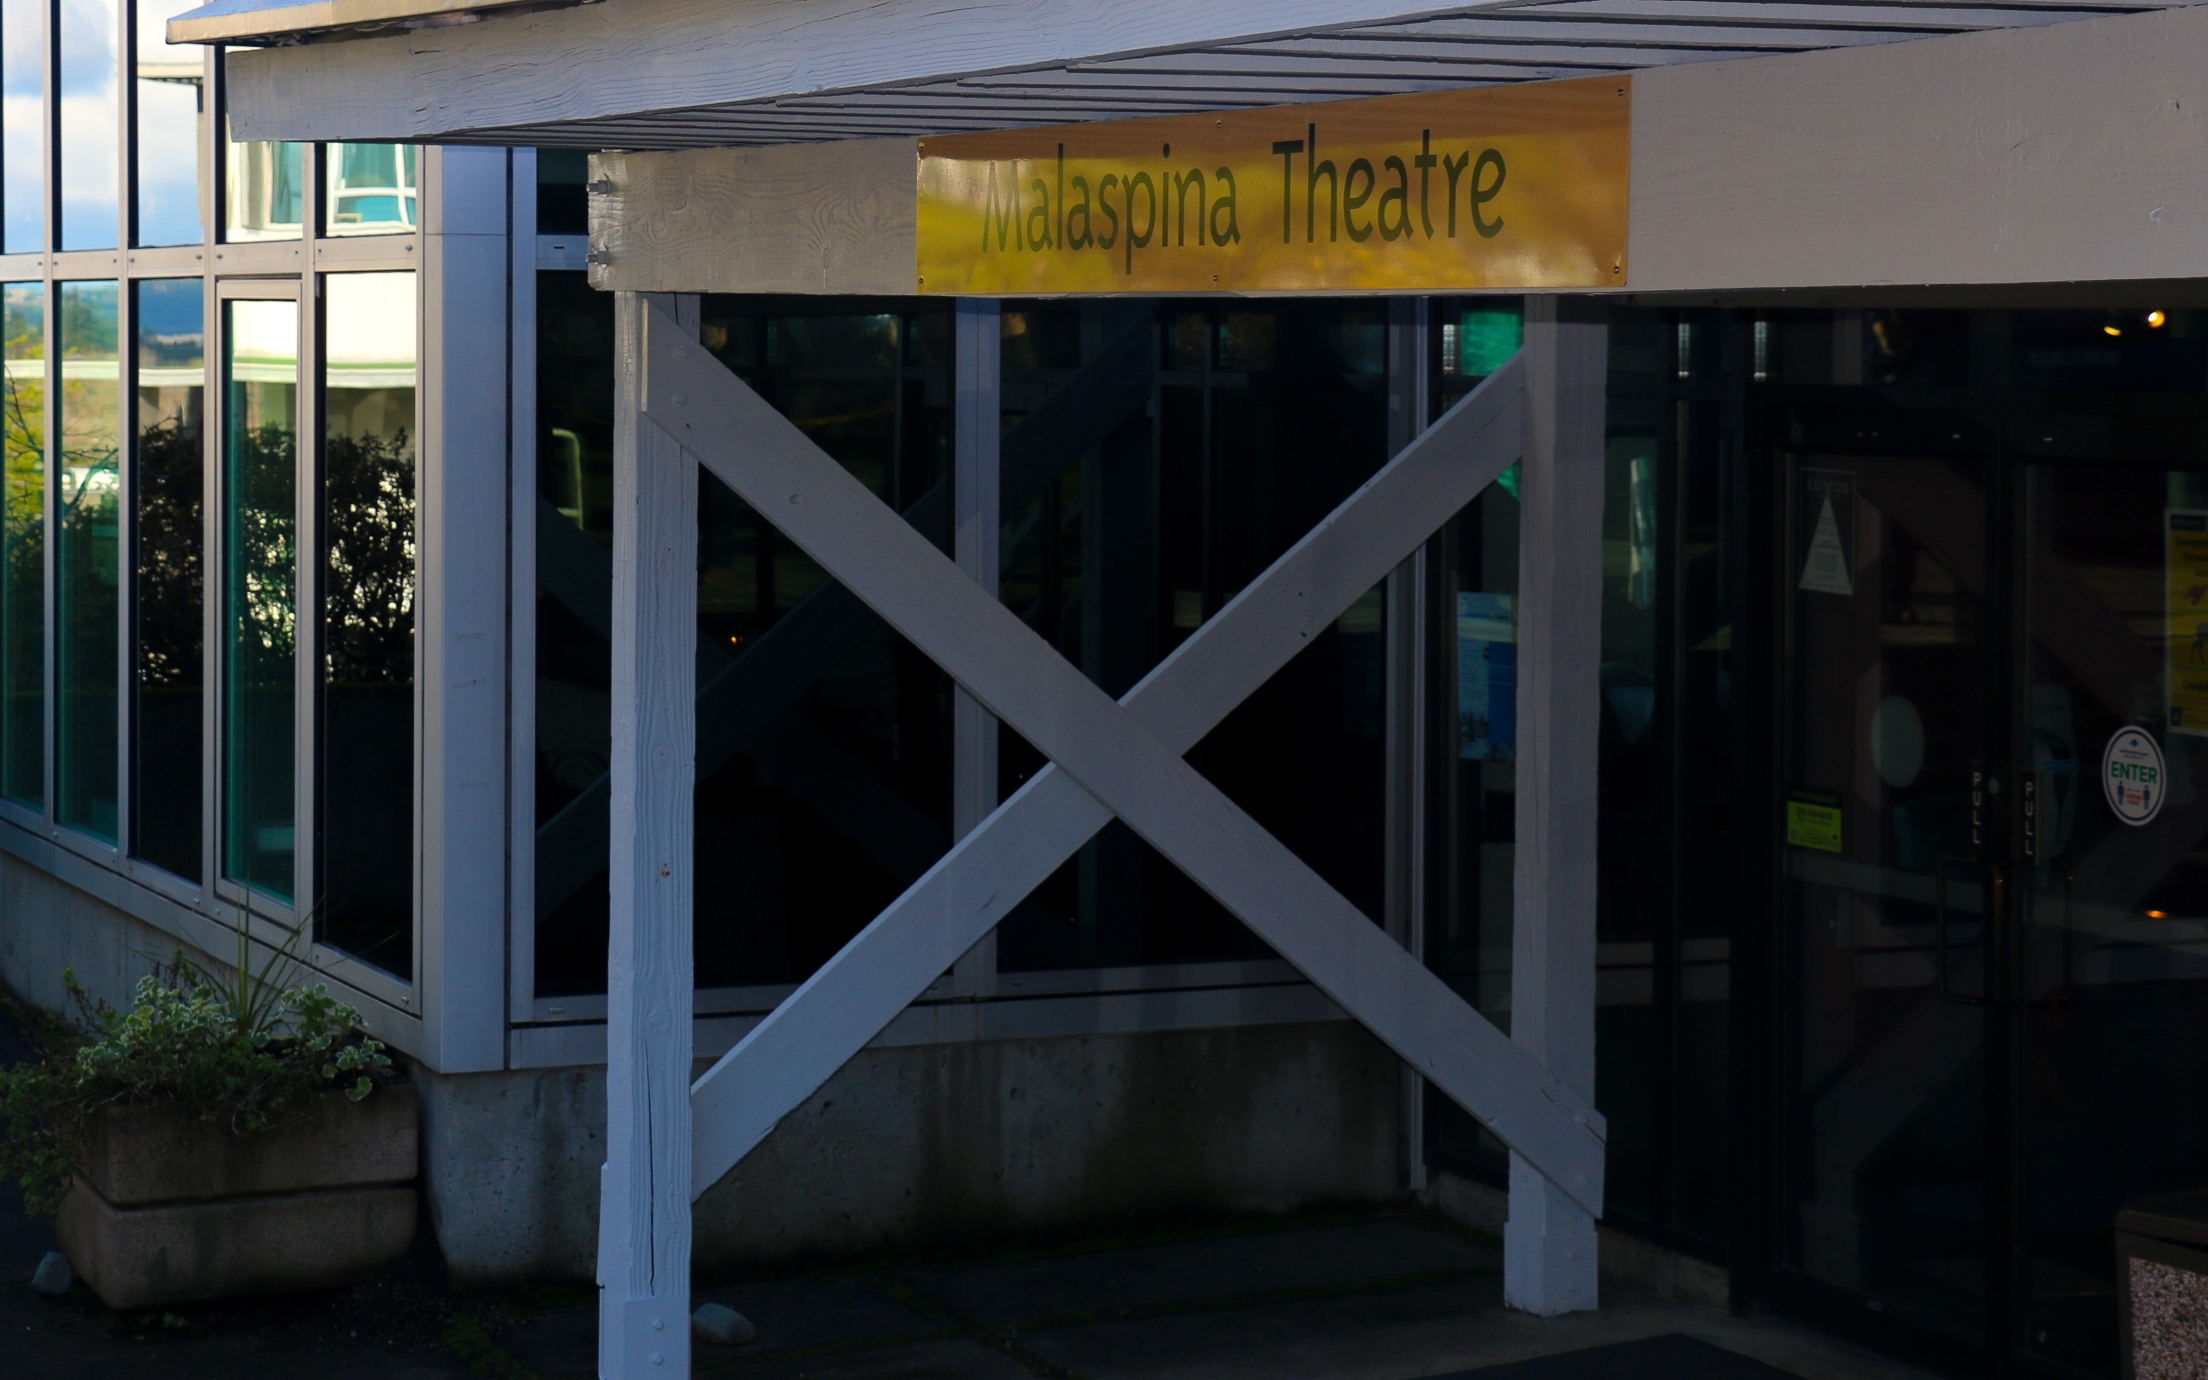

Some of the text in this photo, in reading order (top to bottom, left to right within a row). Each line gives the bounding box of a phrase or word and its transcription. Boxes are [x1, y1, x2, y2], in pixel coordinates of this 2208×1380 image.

[982, 123, 1506, 275] Malaspina Theatre
[1972, 771, 1983, 844] PULL
[2110, 761, 2158, 784] ENTER
[2024, 781, 2034, 855] PULL
